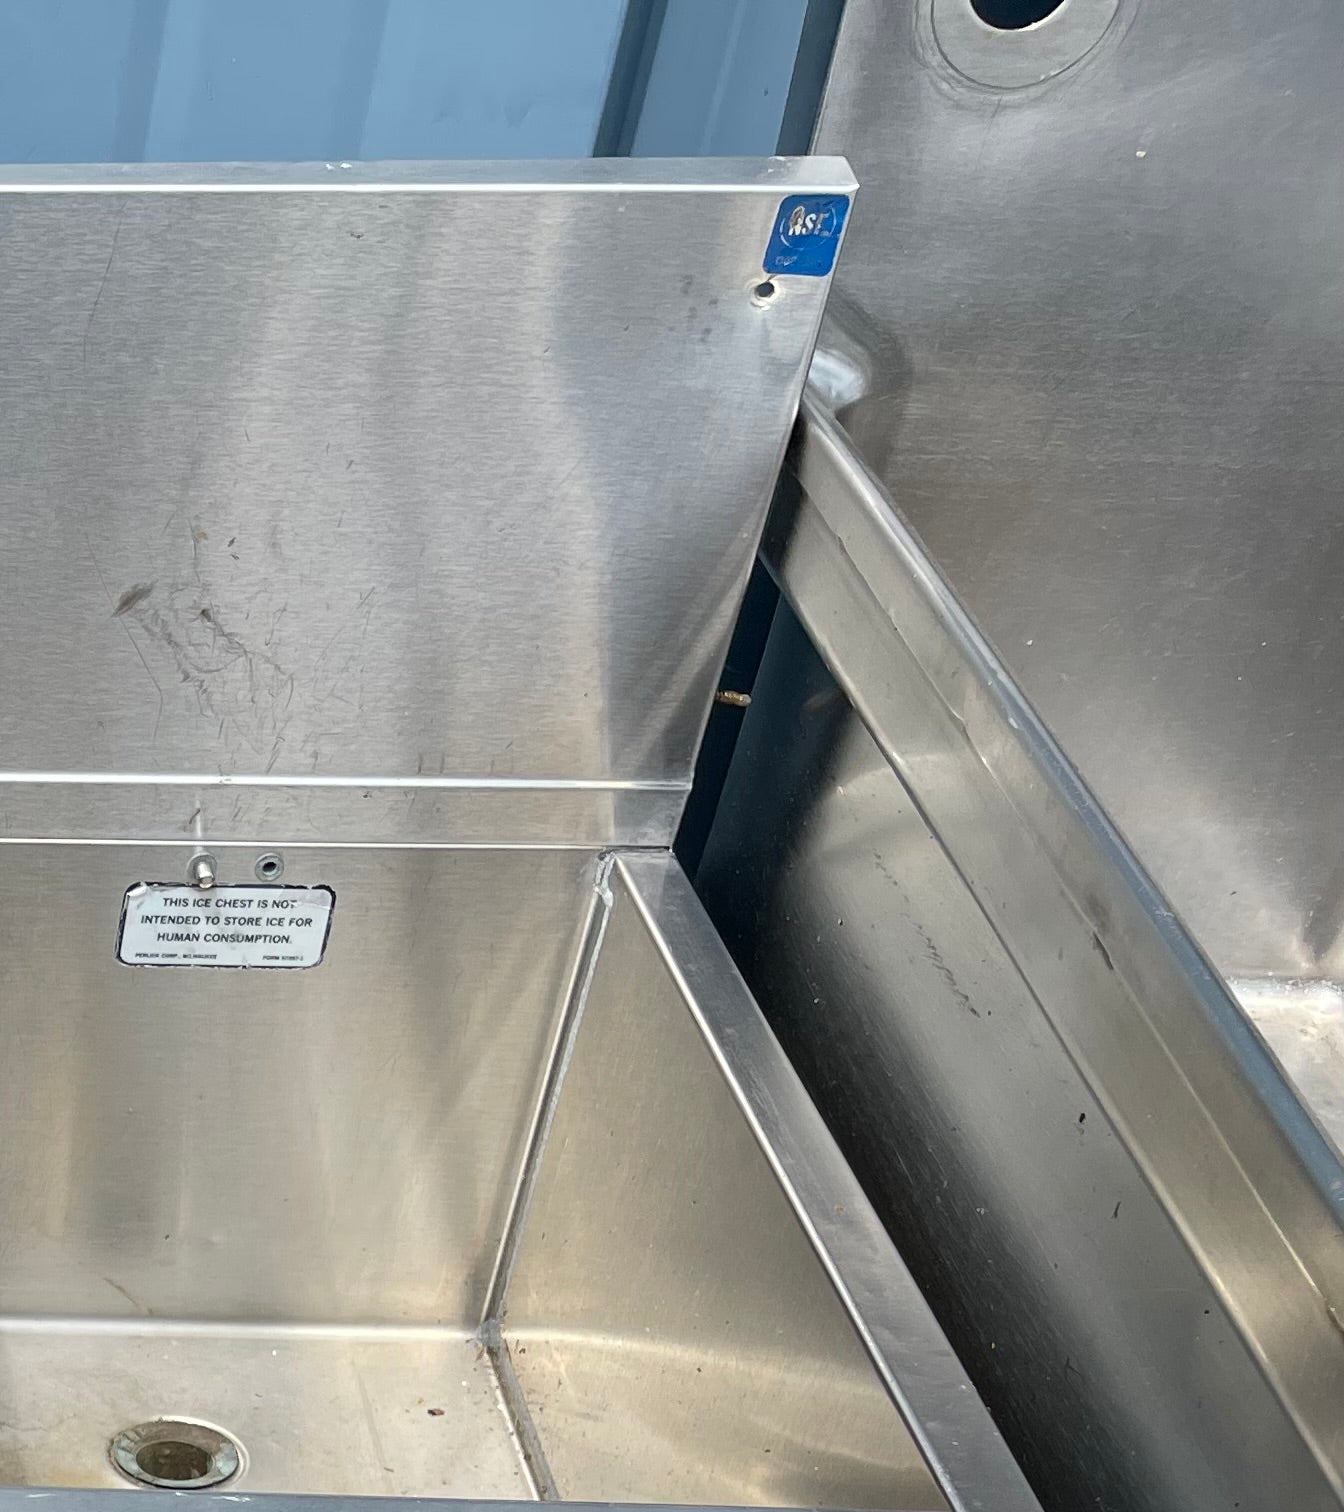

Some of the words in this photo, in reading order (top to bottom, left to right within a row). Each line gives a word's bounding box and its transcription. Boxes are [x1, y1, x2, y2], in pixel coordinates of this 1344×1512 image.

[163, 898, 189, 908] THIS
[192, 898, 211, 908] ICE
[215, 898, 253, 908] CHEST
[257, 899, 268, 909] IS
[140, 915, 201, 925] INTENDED
[205, 916, 220, 925] TO
[223, 916, 262, 926] STORE
[265, 917, 285, 927] ICE
[289, 917, 313, 927] FOR
[156, 932, 200, 943] HUMAN
